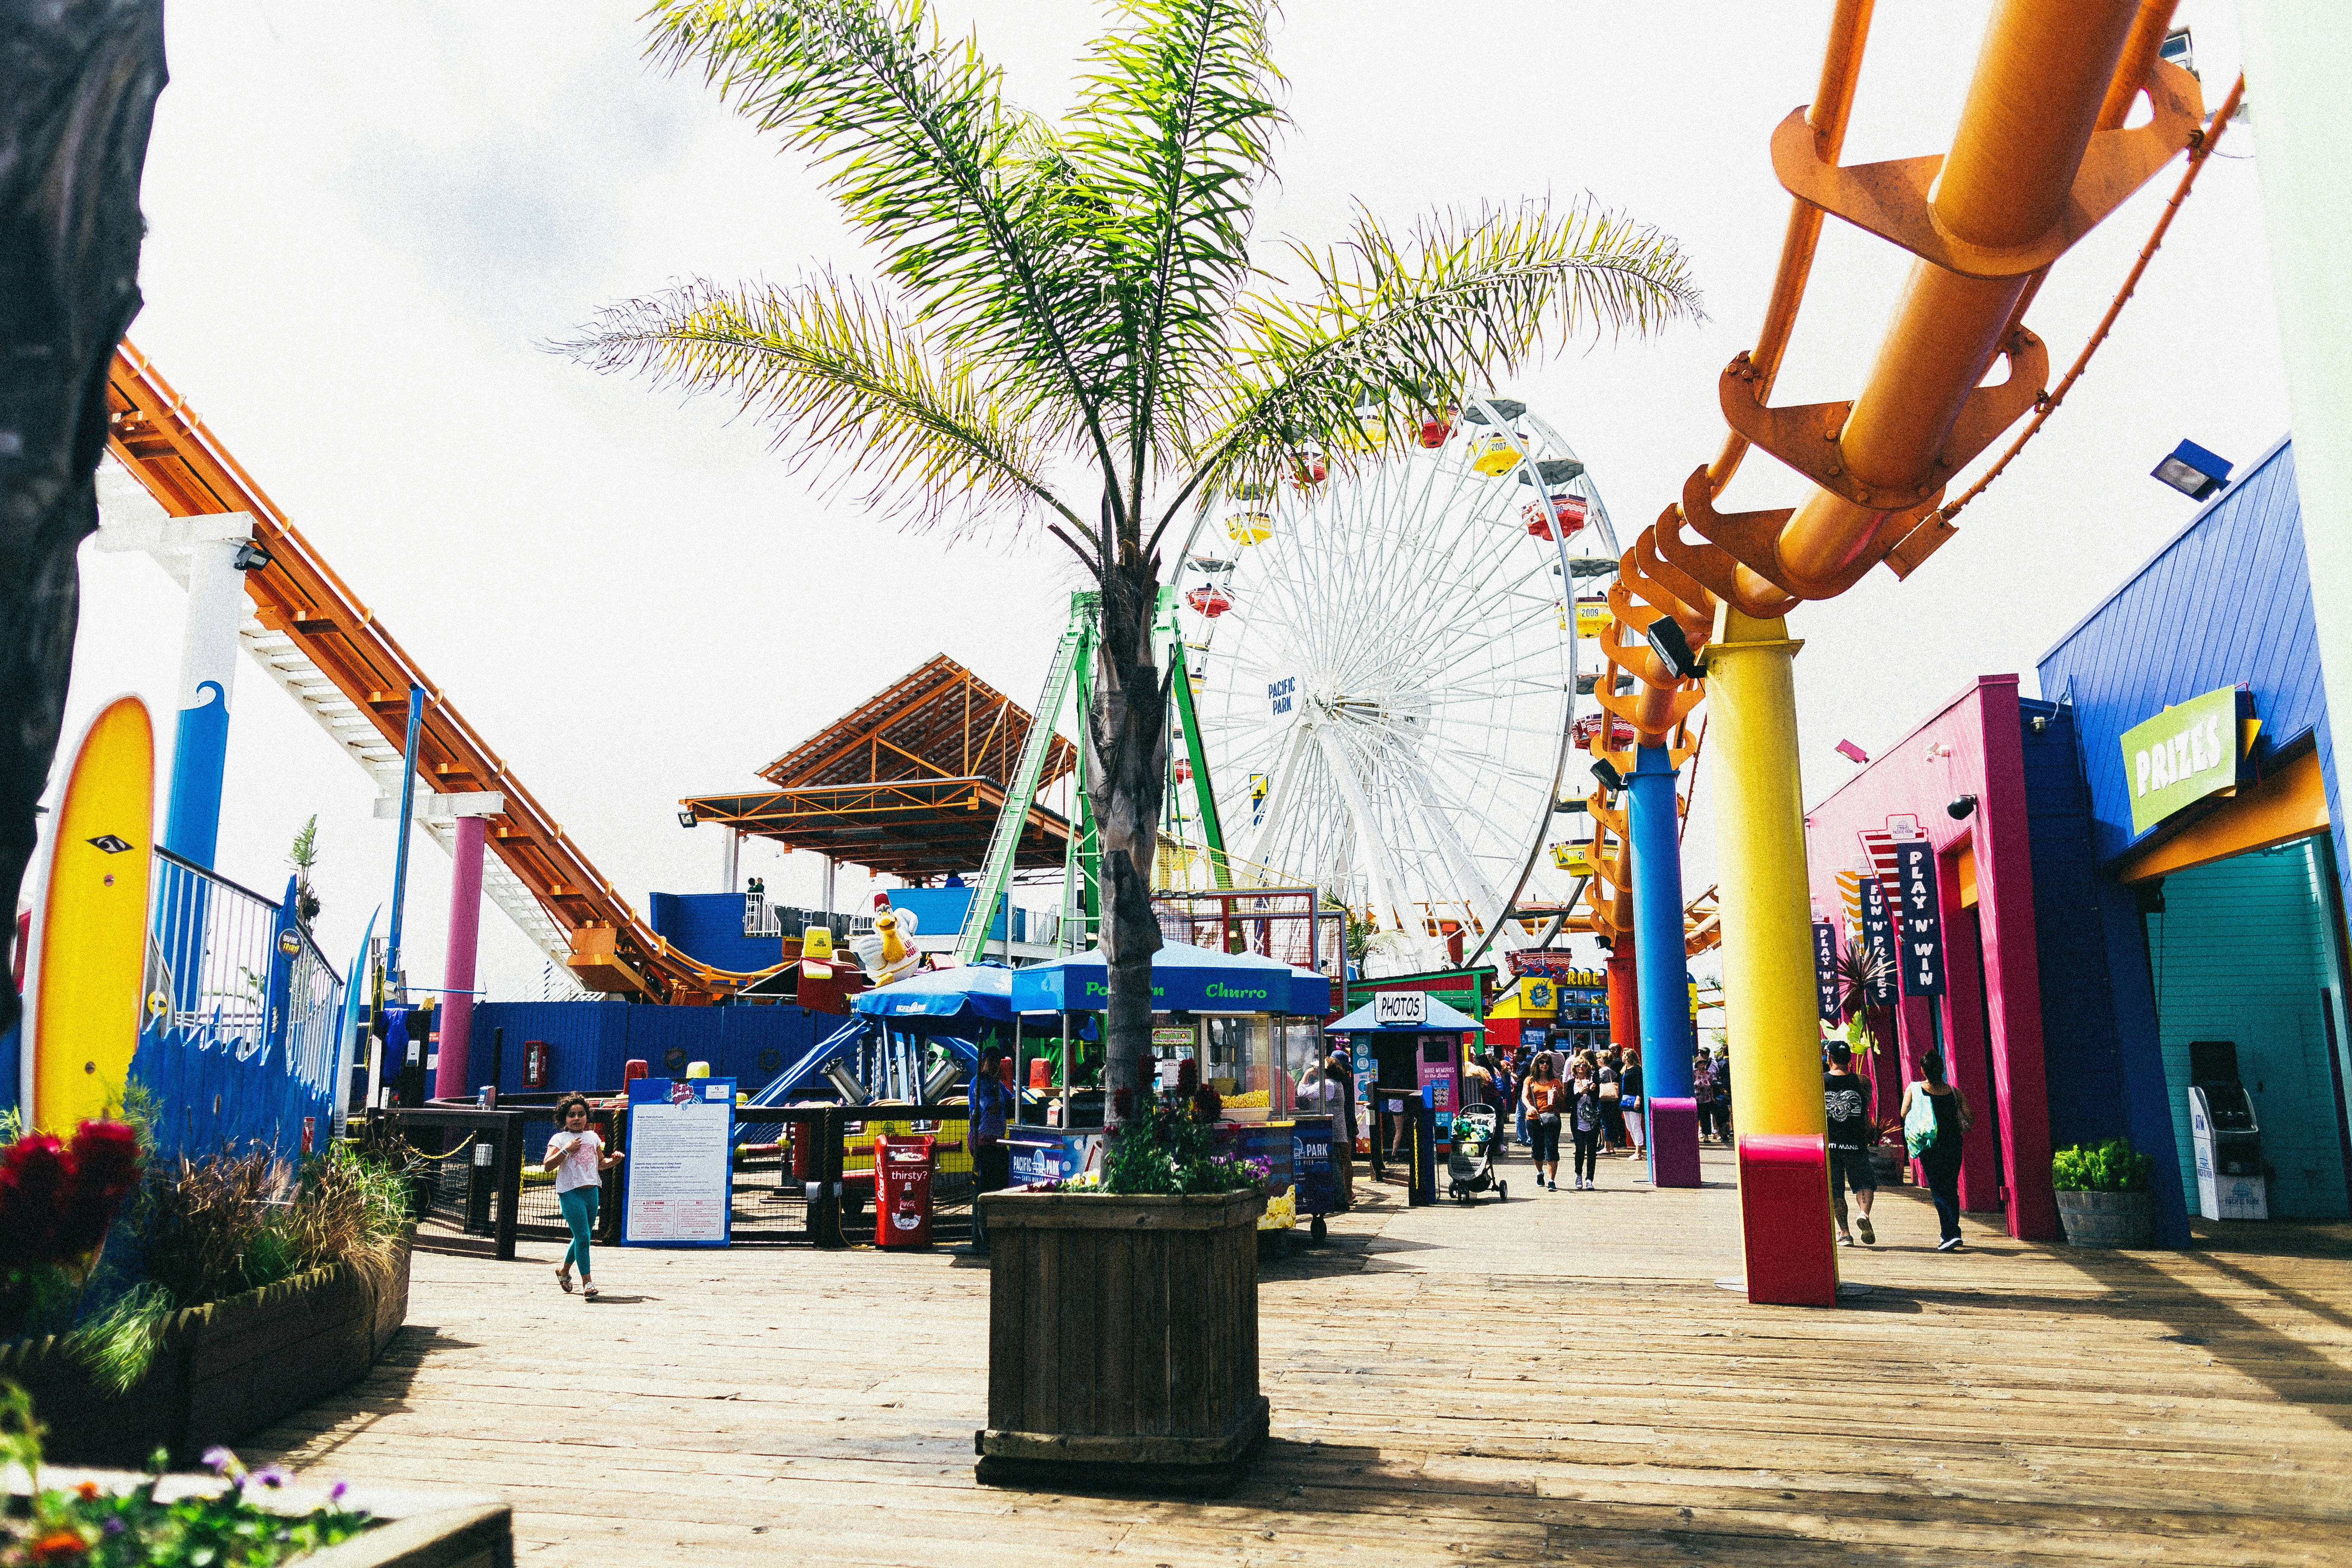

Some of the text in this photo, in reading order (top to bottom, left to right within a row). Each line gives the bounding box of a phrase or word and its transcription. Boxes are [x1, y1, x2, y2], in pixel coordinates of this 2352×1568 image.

[1491, 442, 1507, 451] 2007
[1582, 608, 1599, 617] 2009
[1268, 676, 1295, 699] PACIFIC
[1273, 695, 1292, 715] PARK
[2135, 714, 2222, 798] PRIZES
[1869, 885, 1882, 916] FUN
[1867, 921, 1888, 931] 'N'
[1909, 851, 1933, 985] PLAY 'N' WIN
[906, 946, 918, 958] GUA
[1567, 971, 1600, 985] RIDE
[1819, 929, 1834, 1012] PLAY 'N' WIN
[1206, 982, 1267, 998] Churro
[1381, 997, 1420, 1017] PHOTOS
[2196, 1114, 2205, 1130] ATM
[1307, 1143, 1328, 1157] PARK
[1014, 1156, 1060, 1176] PACIFIC PARK
[891, 1171, 928, 1181] thirsty?
